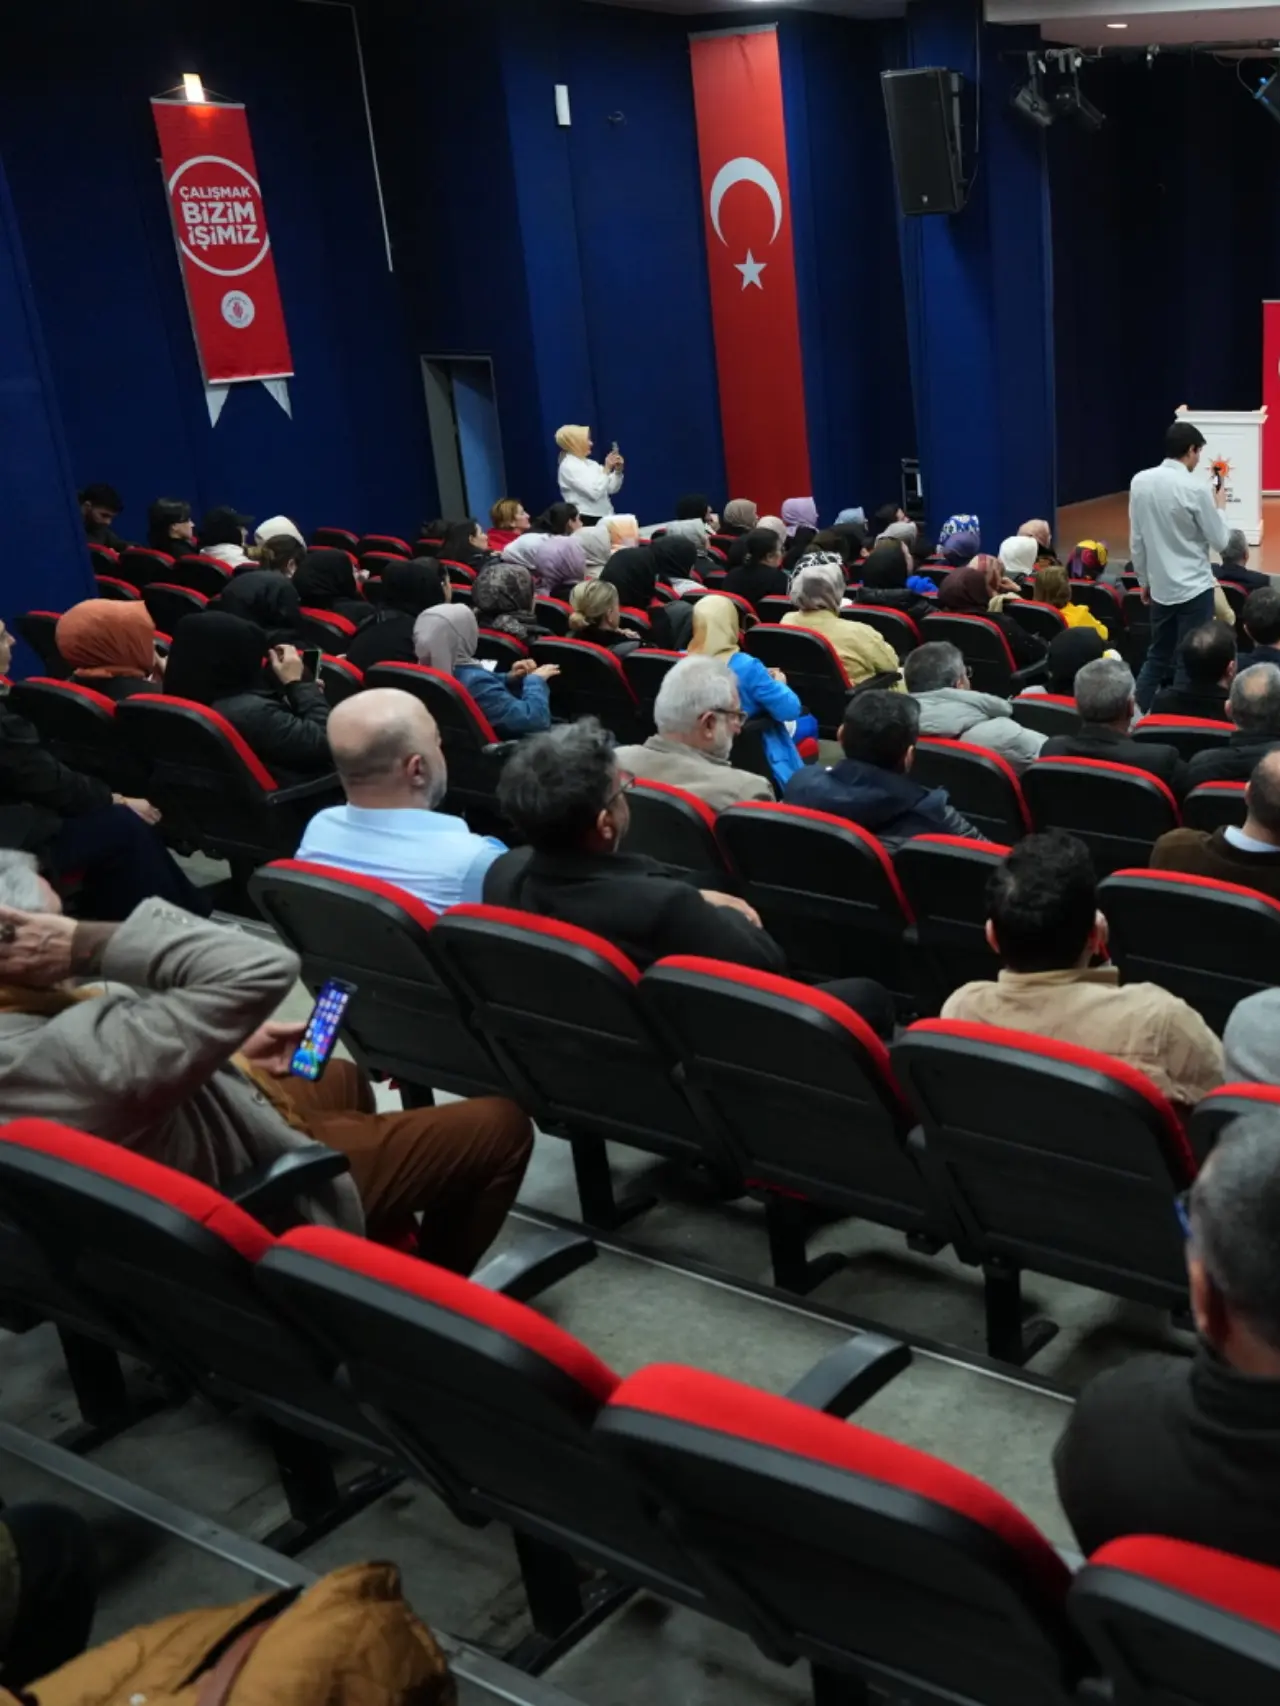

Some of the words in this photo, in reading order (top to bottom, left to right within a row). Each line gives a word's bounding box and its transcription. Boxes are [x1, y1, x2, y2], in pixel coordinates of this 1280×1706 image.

[180, 186, 252, 201] ÇALIŞMAK
[181, 201, 257, 224] BİZİM
[187, 223, 260, 251] İŞİMİZ
